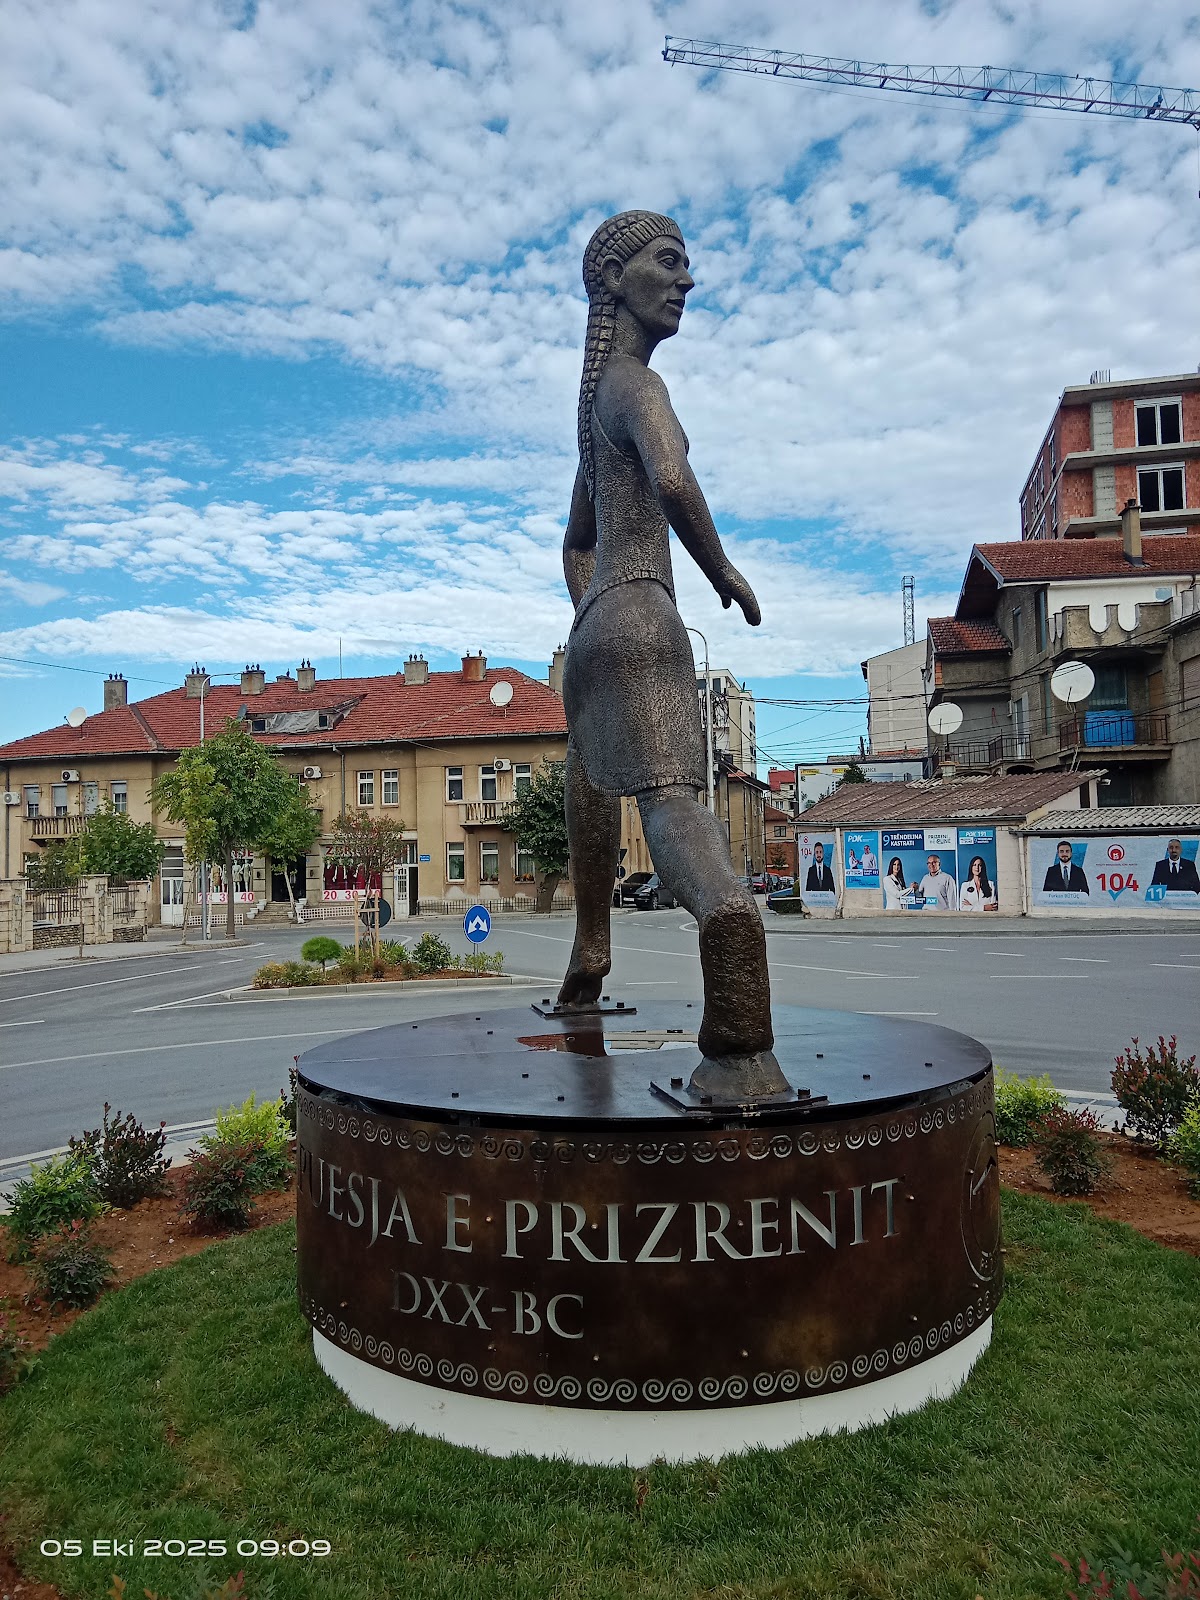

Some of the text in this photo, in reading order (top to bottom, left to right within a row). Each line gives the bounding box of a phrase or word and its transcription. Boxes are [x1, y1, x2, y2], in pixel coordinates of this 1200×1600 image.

[883, 834, 890, 846] 9
[1096, 873, 1139, 891] 104
[240, 892, 254, 902] 40
[323, 890, 337, 900] 20
[1147, 888, 1164, 899] 11
[441, 1192, 473, 1254] E
[500, 1177, 905, 1264] PRIZRENIT
[390, 1268, 586, 1340] DXX-BC
